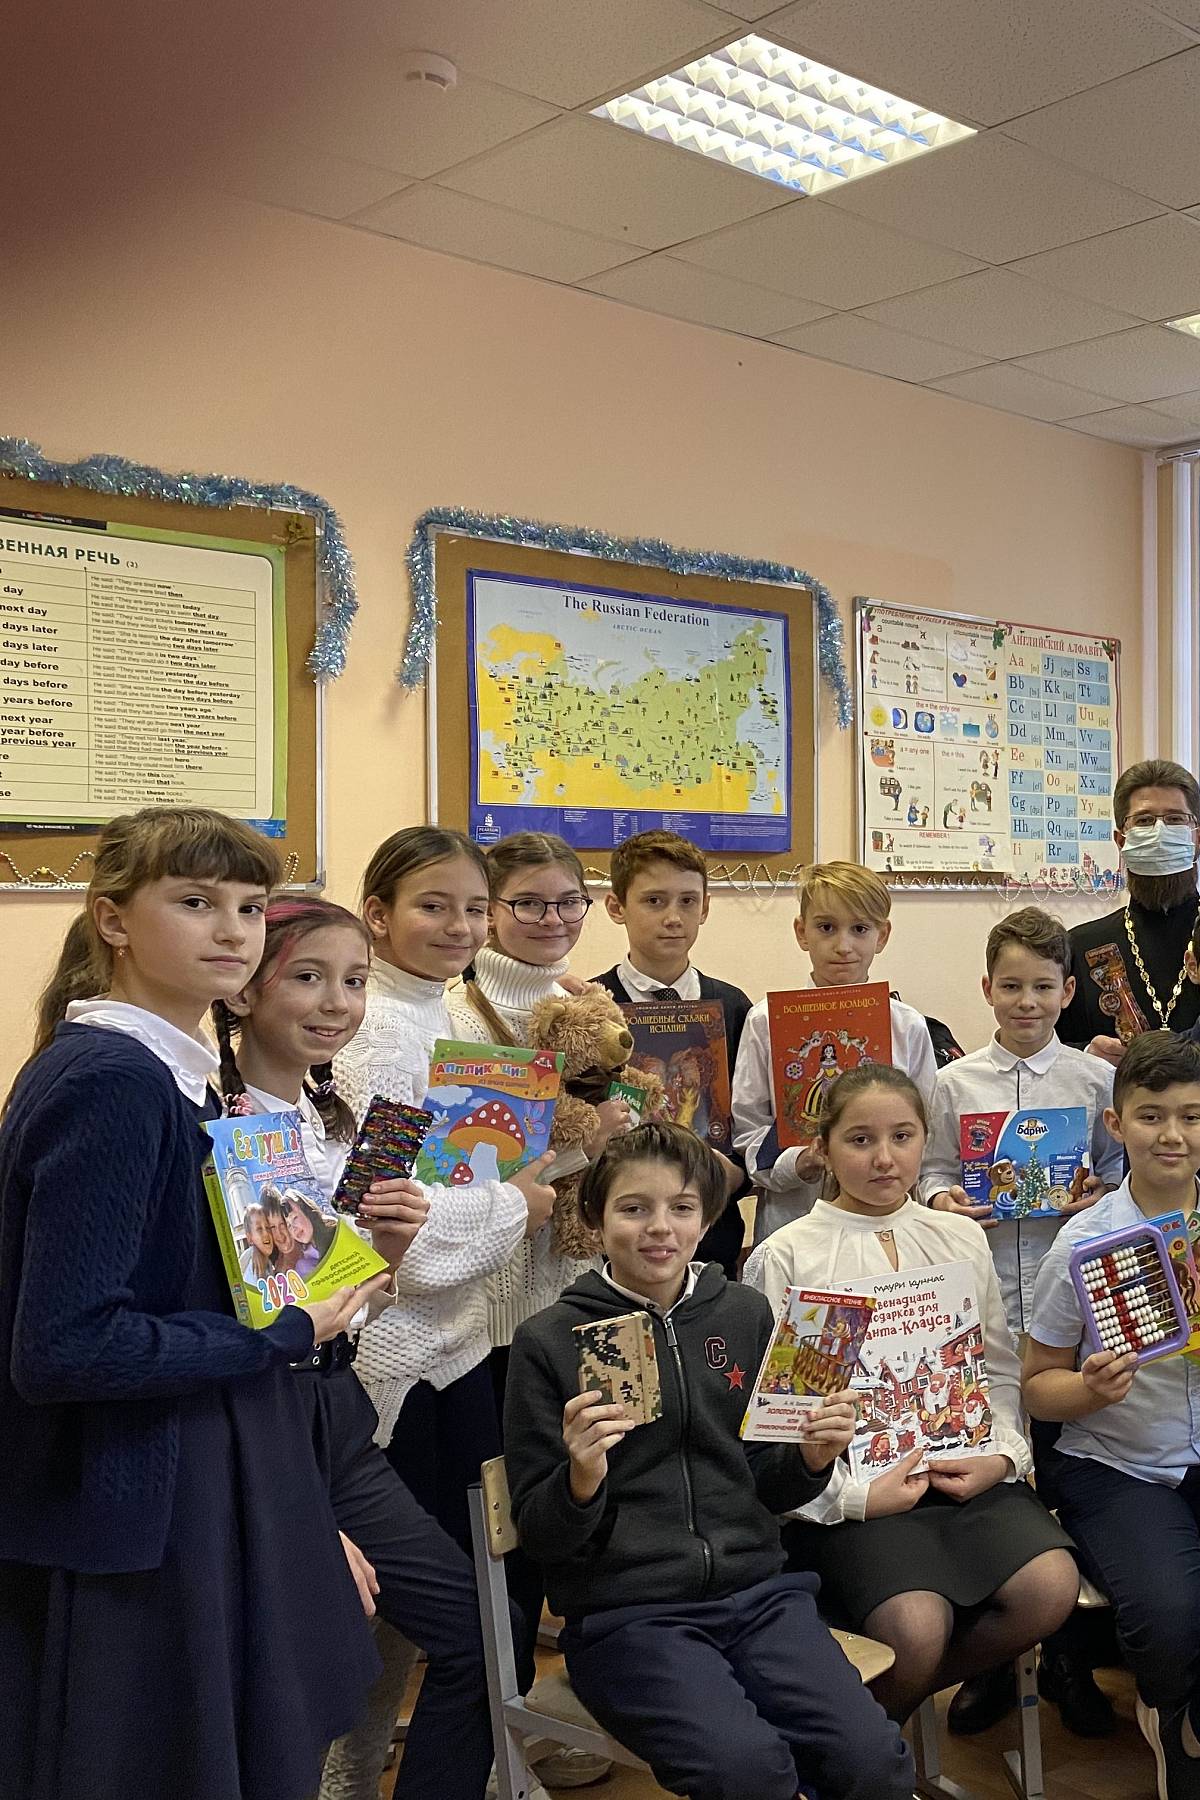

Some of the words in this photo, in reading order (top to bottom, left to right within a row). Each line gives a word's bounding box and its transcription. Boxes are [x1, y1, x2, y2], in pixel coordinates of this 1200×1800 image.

[75, 548, 120, 566] РЕЧЬ
[3, 585, 24, 596] day
[0, 604, 24, 613] next
[27, 606, 47, 617] day
[562, 595, 588, 610] The
[592, 599, 640, 618] Russian
[644, 606, 710, 627] Federation
[2, 621, 29, 632] days
[32, 624, 58, 635] later
[2, 640, 29, 650] days
[32, 643, 58, 653] later
[1012, 634, 1065, 652] АНГЛИЙСКИЙ
[1067, 643, 1103, 657] АЛФАВИТ
[0, 658, 20, 668] day
[23, 660, 59, 671] before
[1008, 652, 1024, 667] Aa
[1043, 657, 1054, 674] Jj
[1077, 662, 1091, 676] Ss
[3, 676, 29, 687] days
[33, 679, 68, 690] before
[1009, 675, 1025, 690] Bb
[1043, 680, 1060, 694] Kk
[1078, 684, 1092, 698] Tt
[3, 695, 34, 705] years
[37, 696, 73, 708] before
[1009, 699, 1025, 714] Cc
[1045, 703, 1057, 718] Ll
[1079, 706, 1094, 721] Uu
[0, 714, 26, 723] next
[28, 716, 54, 725] year
[0, 727, 26, 736] year
[28, 727, 65, 738] before
[1010, 723, 1027, 737] Dd
[1045, 726, 1065, 741] Mm
[1080, 729, 1094, 743] Vv
[1, 736, 49, 747] previous
[51, 739, 77, 749] year
[1010, 747, 1025, 762] Ee
[1046, 750, 1062, 764] Nn
[1080, 751, 1098, 766] Ww
[1011, 770, 1024, 784] Ff
[1046, 773, 1060, 786] Oo
[1080, 775, 1095, 789] Xx
[1011, 795, 1026, 812] Gg
[1047, 797, 1060, 812] Pp
[1080, 799, 1094, 814] Yy
[1013, 819, 1028, 833] Hh
[1047, 820, 1061, 836] Qq
[1080, 821, 1093, 835] Zz
[1013, 843, 1022, 855] Ii
[1048, 843, 1062, 857] Rr
[783, 1001, 837, 1014] ВОЛШЕБНОЕ
[839, 997, 876, 1009] КОЛЬЦО
[677, 1013, 710, 1024] СКАЗКИ
[649, 1023, 687, 1034] ИСПАНИИ
[435, 1062, 528, 1079] АППЛИКАЦИЯ
[1016, 1123, 1049, 1137] Барни
[257, 1269, 309, 1313] 2020
[803, 1294, 841, 1304] ВНЕКЛАССНОЕ
[843, 1298, 863, 1306] ЧТЕНИЕ
[874, 1291, 937, 1312] венадцать
[918, 1302, 939, 1316] для
[865, 1314, 951, 1340] анта-Клауса
